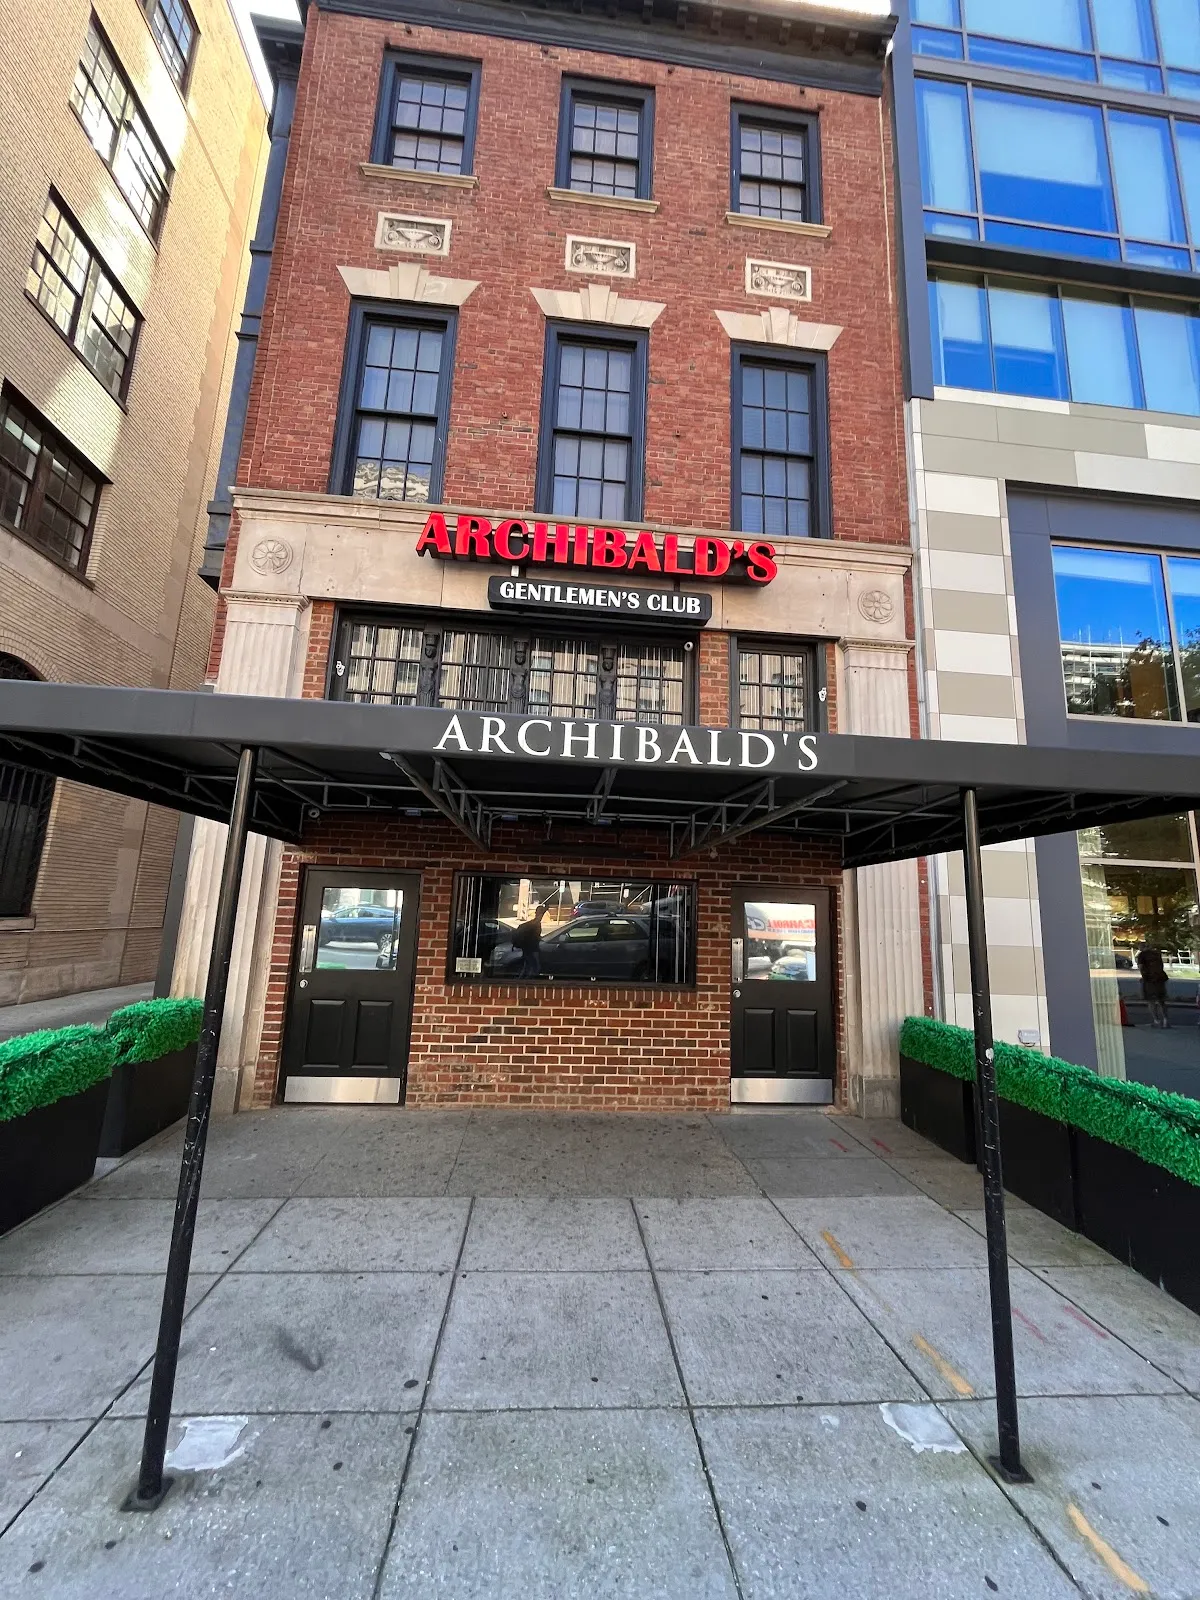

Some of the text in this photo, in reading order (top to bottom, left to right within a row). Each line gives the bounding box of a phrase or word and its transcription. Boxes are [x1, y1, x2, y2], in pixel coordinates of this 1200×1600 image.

[415, 512, 778, 584] ARCHIBALD'S
[500, 580, 701, 614] GENTLEMEN'S CLUB
[433, 714, 819, 772] ARCHIBALD'S
